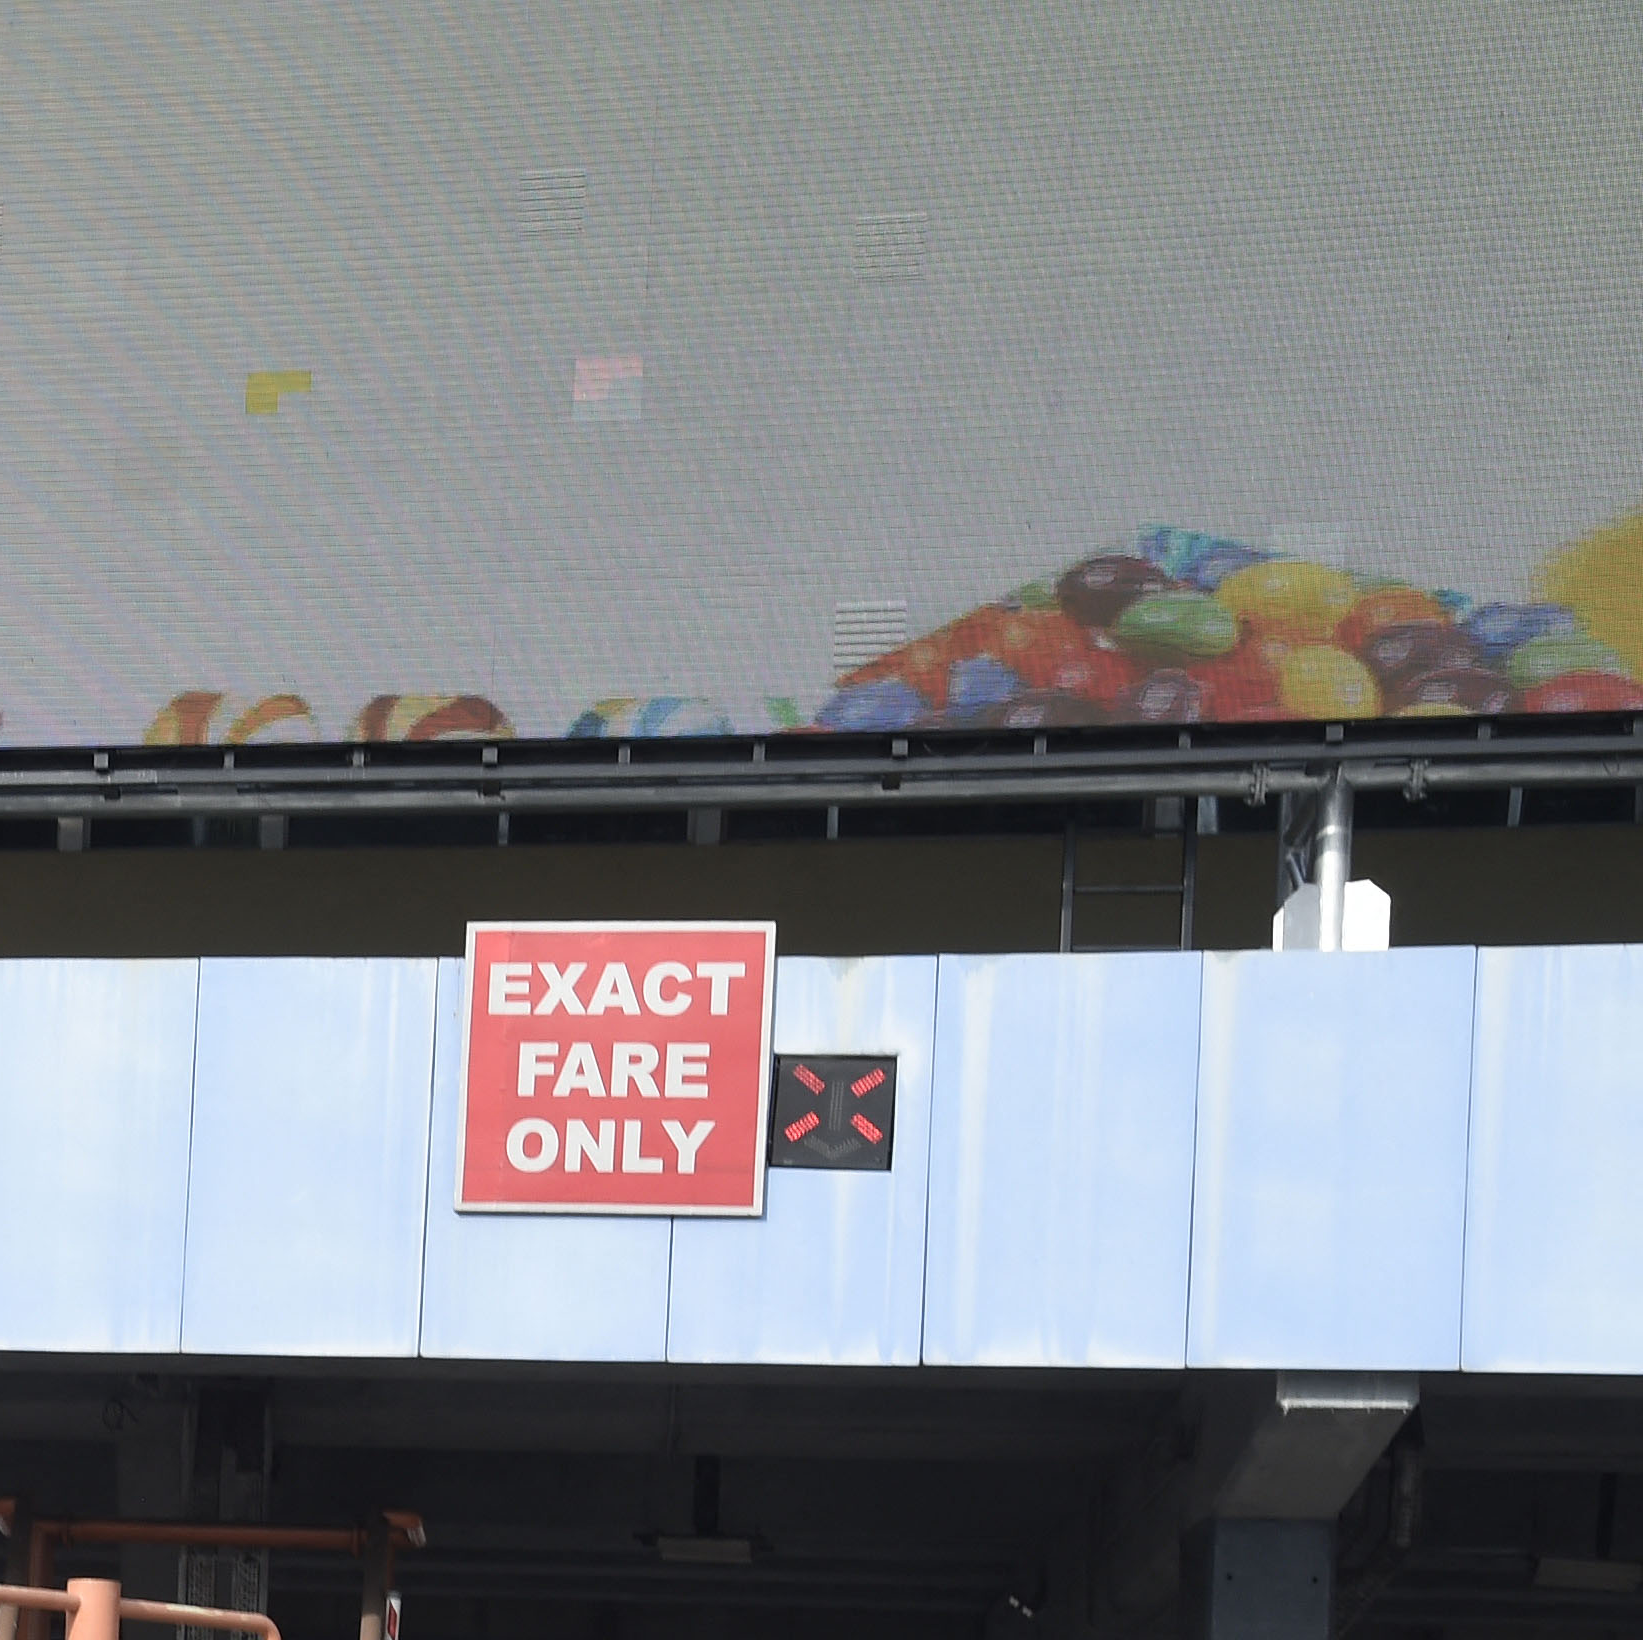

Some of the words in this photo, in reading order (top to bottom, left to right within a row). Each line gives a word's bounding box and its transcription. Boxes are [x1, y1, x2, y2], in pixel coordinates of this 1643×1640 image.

[488, 961, 746, 1017] EXACT
[518, 1042, 711, 1098] FARE
[505, 1118, 716, 1174] ONLY
